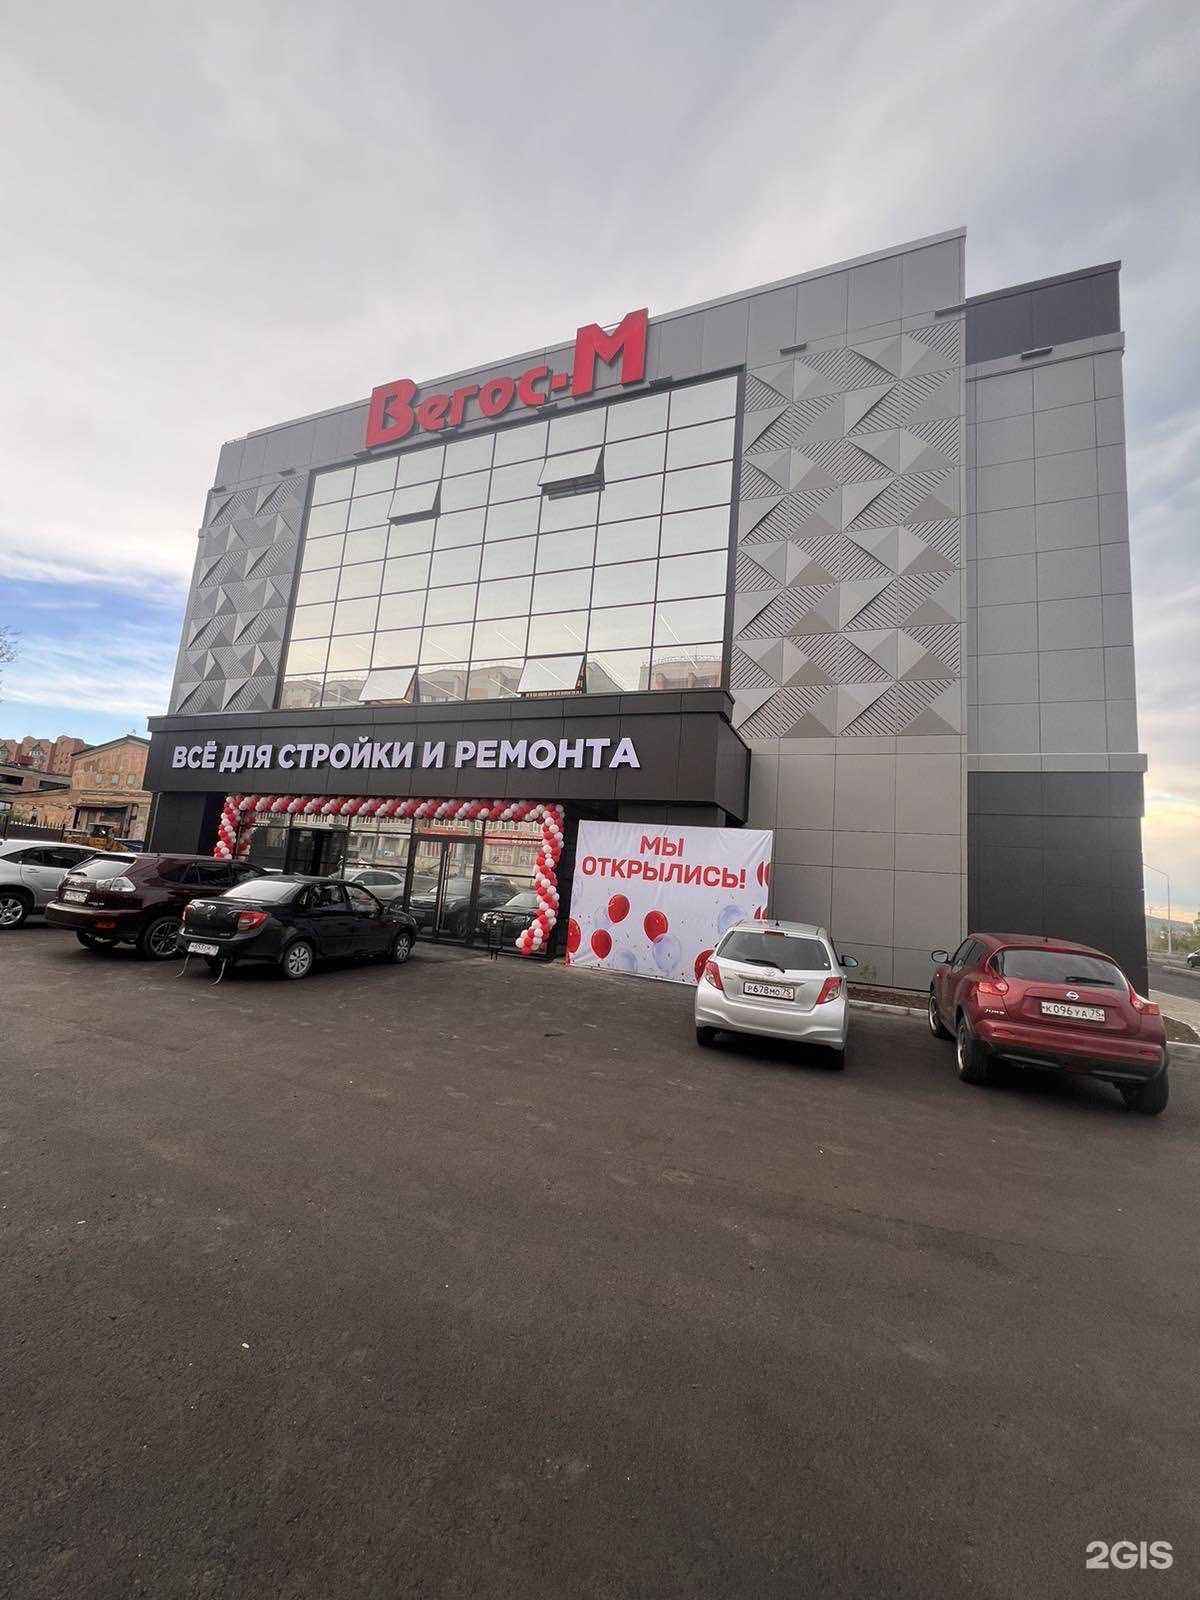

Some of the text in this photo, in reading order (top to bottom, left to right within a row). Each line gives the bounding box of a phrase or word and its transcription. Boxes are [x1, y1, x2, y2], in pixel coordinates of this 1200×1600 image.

[366, 307, 649, 450] Вегос-М
[171, 736, 641, 774] ВСЁ ДЛЯ СТРОЙКИ И РЕМОНТА
[639, 834, 685, 858] МЫ
[581, 855, 748, 890] ОТКРЫЛИСЬ!
